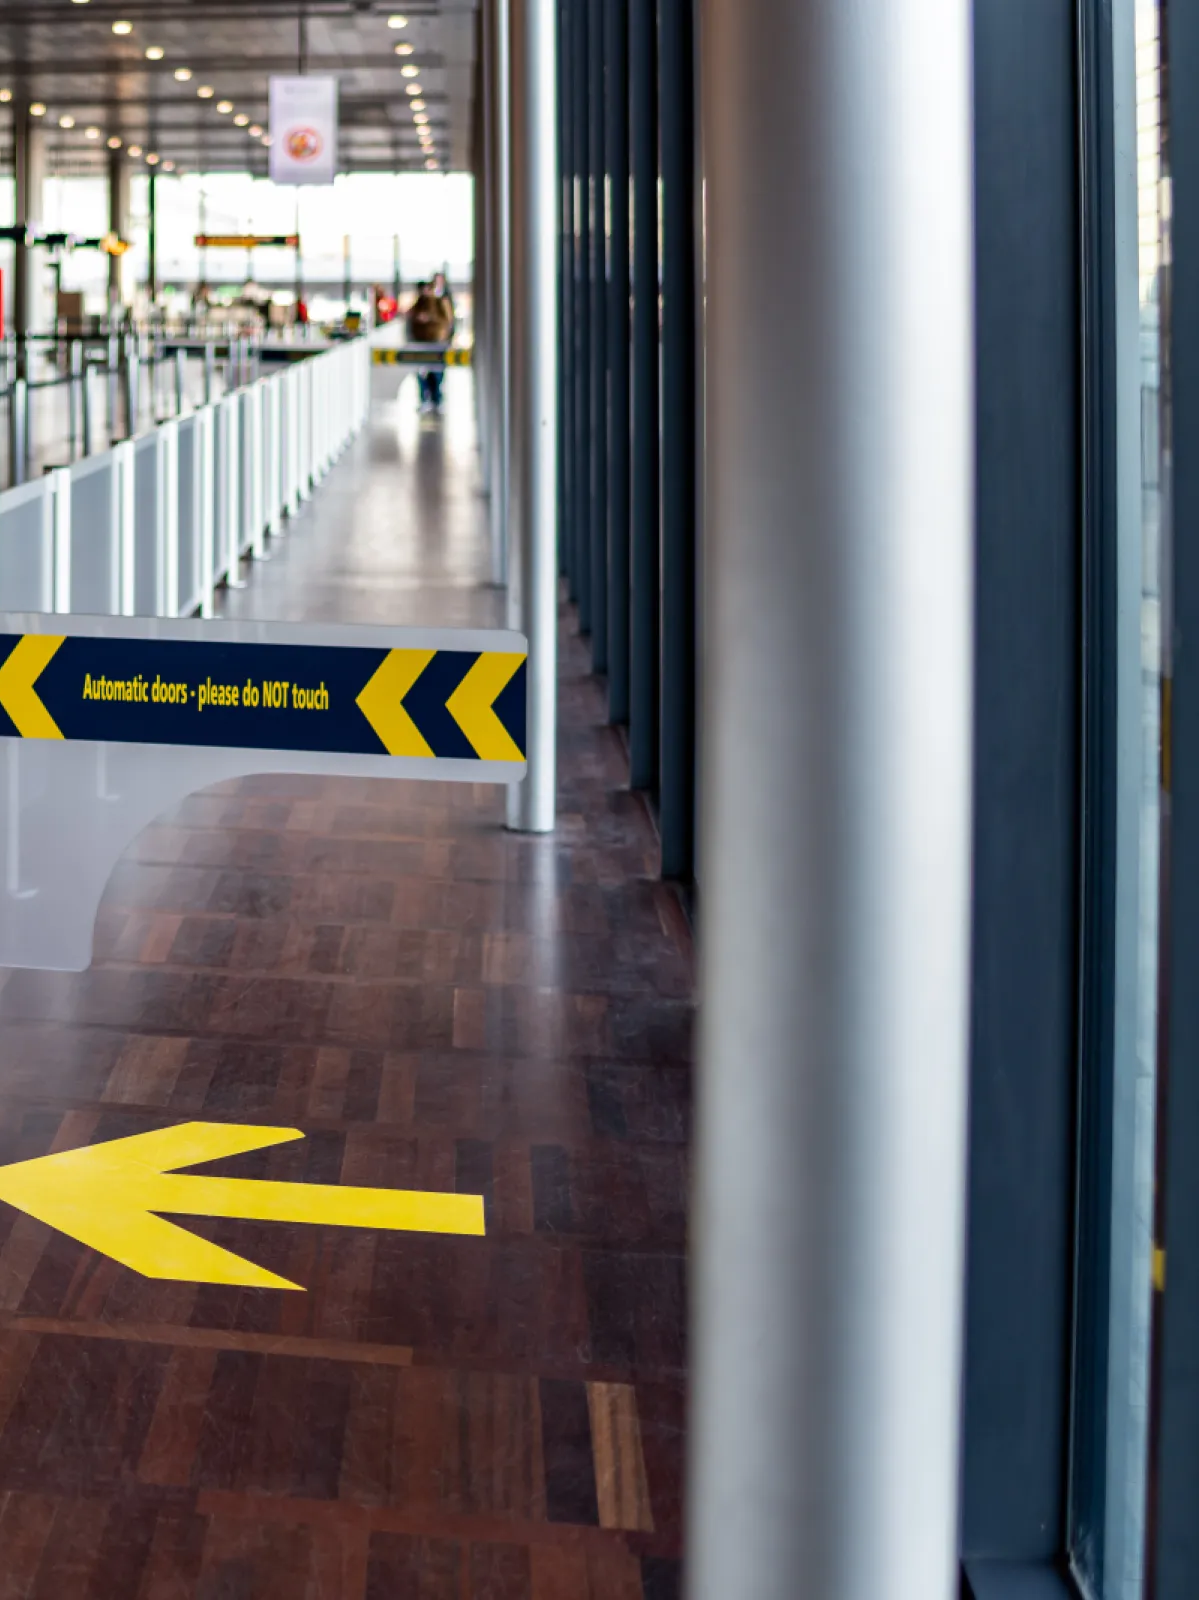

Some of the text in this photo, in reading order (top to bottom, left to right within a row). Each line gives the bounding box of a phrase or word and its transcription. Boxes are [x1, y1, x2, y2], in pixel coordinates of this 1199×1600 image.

[82, 673, 149, 702] Automatic
[151, 674, 188, 704] doors
[198, 676, 240, 712] please
[242, 678, 260, 708] do
[262, 681, 289, 708] NOT
[291, 681, 329, 710] touch
